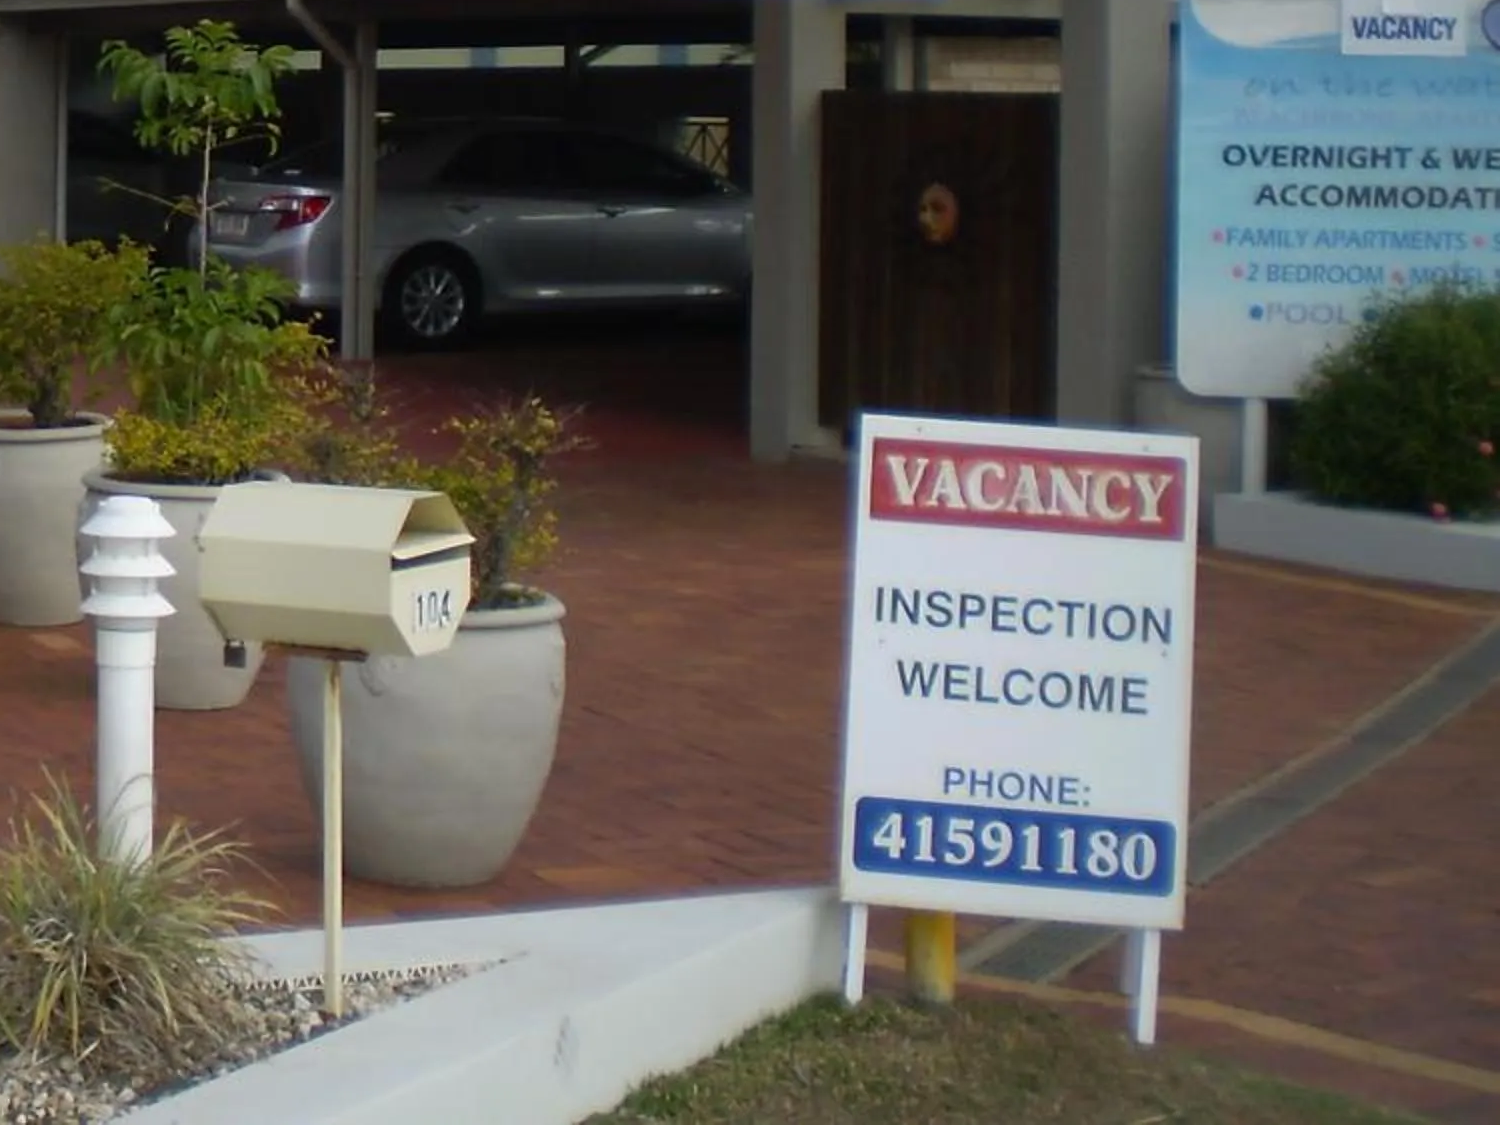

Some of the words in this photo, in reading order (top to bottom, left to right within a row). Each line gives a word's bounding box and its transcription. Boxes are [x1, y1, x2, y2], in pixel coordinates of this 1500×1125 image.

[1351, 15, 1457, 41] VACANCY
[1221, 143, 1413, 170] OVERNIGHT
[1420, 146, 1441, 170] &
[1226, 227, 1308, 249] FAMILY
[1313, 228, 1468, 252] APARTMENTS
[1247, 264, 1259, 283] 2
[1266, 263, 1383, 285] BEDROOM
[1266, 300, 1351, 326] POOL
[886, 454, 1174, 523] VACANCY
[417, 590, 451, 628] 104
[875, 586, 1173, 645] INSPECTION
[896, 658, 1149, 715] WELCOME
[942, 767, 1092, 807] PHONE:
[873, 812, 1157, 881] 41591180
